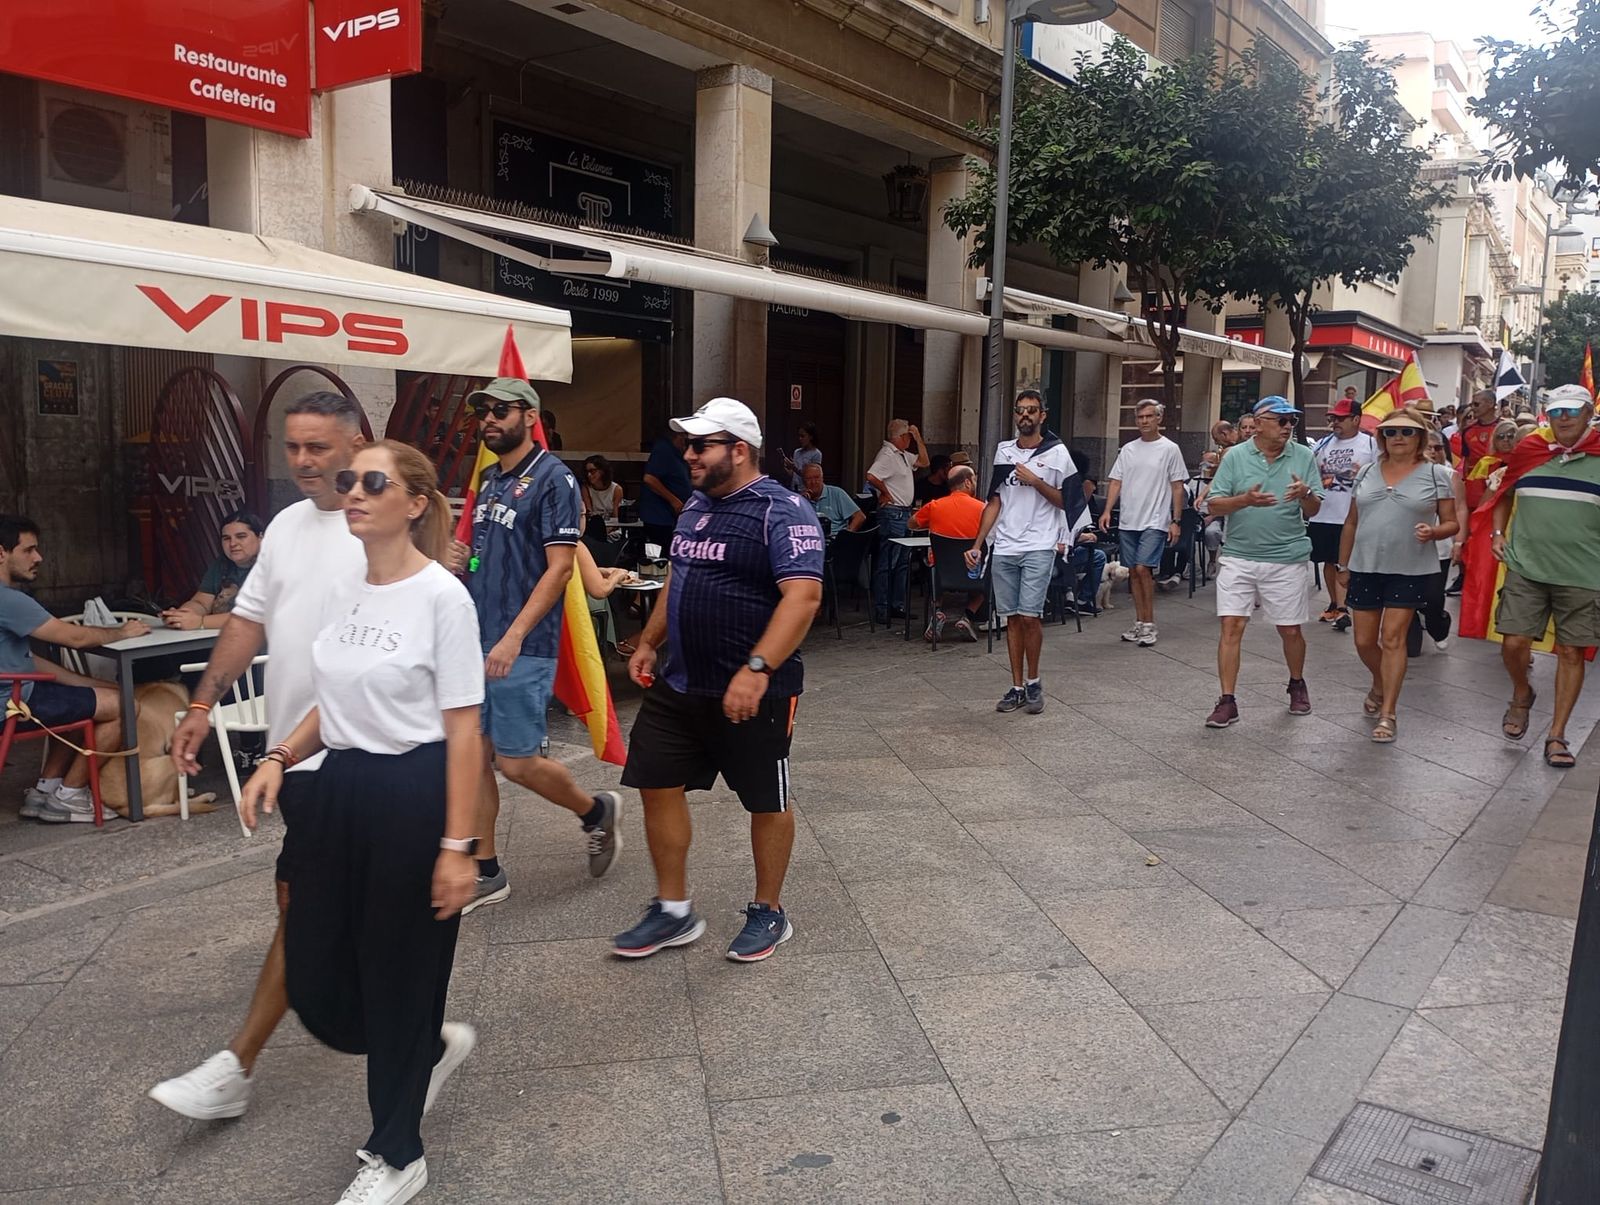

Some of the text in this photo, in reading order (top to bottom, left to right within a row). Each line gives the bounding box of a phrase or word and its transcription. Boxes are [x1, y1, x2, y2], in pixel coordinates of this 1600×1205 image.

[322, 8, 400, 42] VIPS
[174, 43, 288, 88] Restaurante
[189, 78, 276, 114] Cafetería
[563, 279, 620, 303] Desde 1999
[135, 285, 410, 356] VIPS
[158, 473, 242, 500] VIPS
[787, 525, 820, 538] TIERRA
[669, 534, 727, 561] Ceuta
